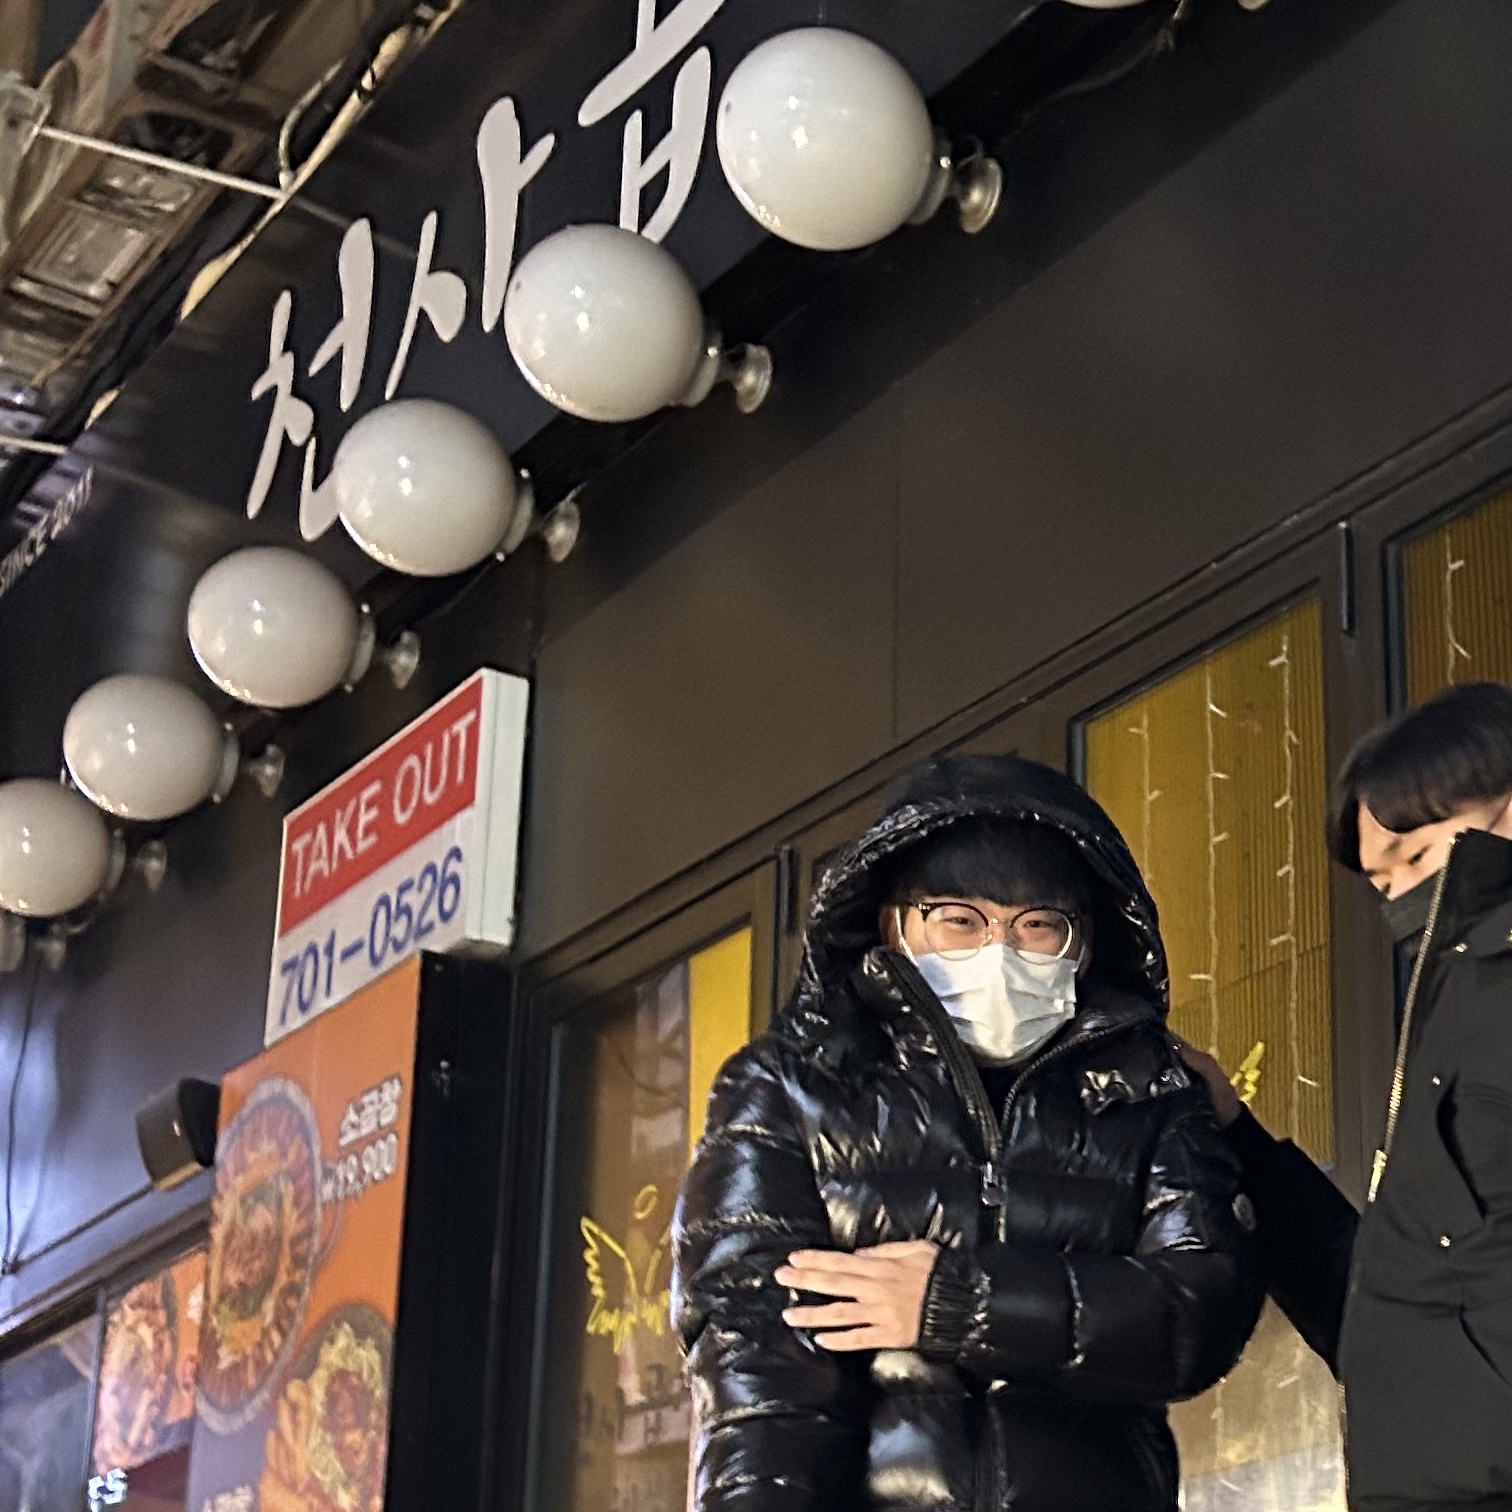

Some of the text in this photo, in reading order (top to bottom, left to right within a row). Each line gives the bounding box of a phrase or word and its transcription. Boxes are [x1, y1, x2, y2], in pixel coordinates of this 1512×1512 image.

[291, 707, 477, 898] TAKE OUT
[279, 845, 463, 1027] 701-0526
